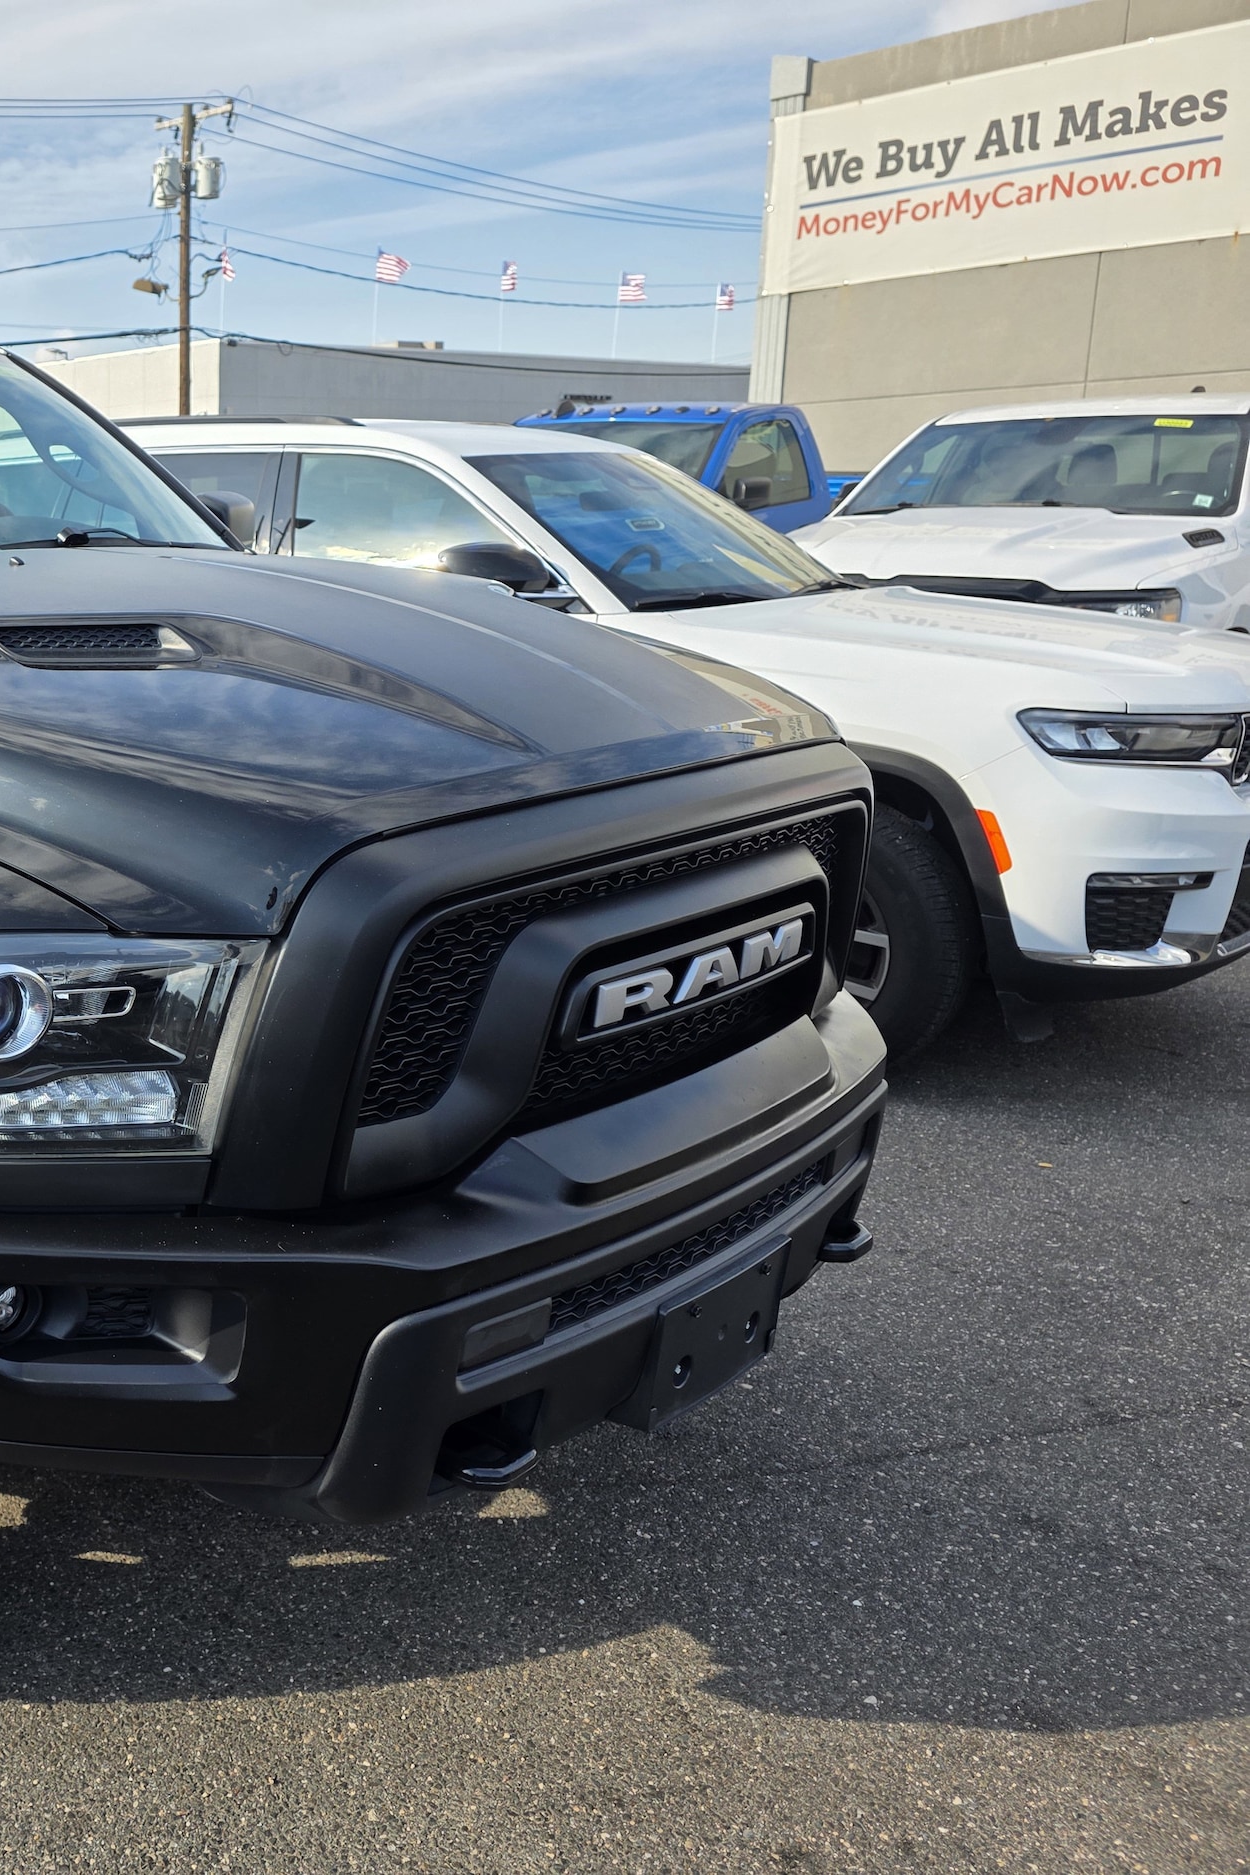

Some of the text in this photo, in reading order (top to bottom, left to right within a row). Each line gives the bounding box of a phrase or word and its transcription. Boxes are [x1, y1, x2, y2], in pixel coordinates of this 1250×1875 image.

[803, 88, 1228, 191] We Buy All Makes
[796, 155, 1223, 240] MoneyForMyCarNow.com
[594, 918, 803, 1029] RAM
